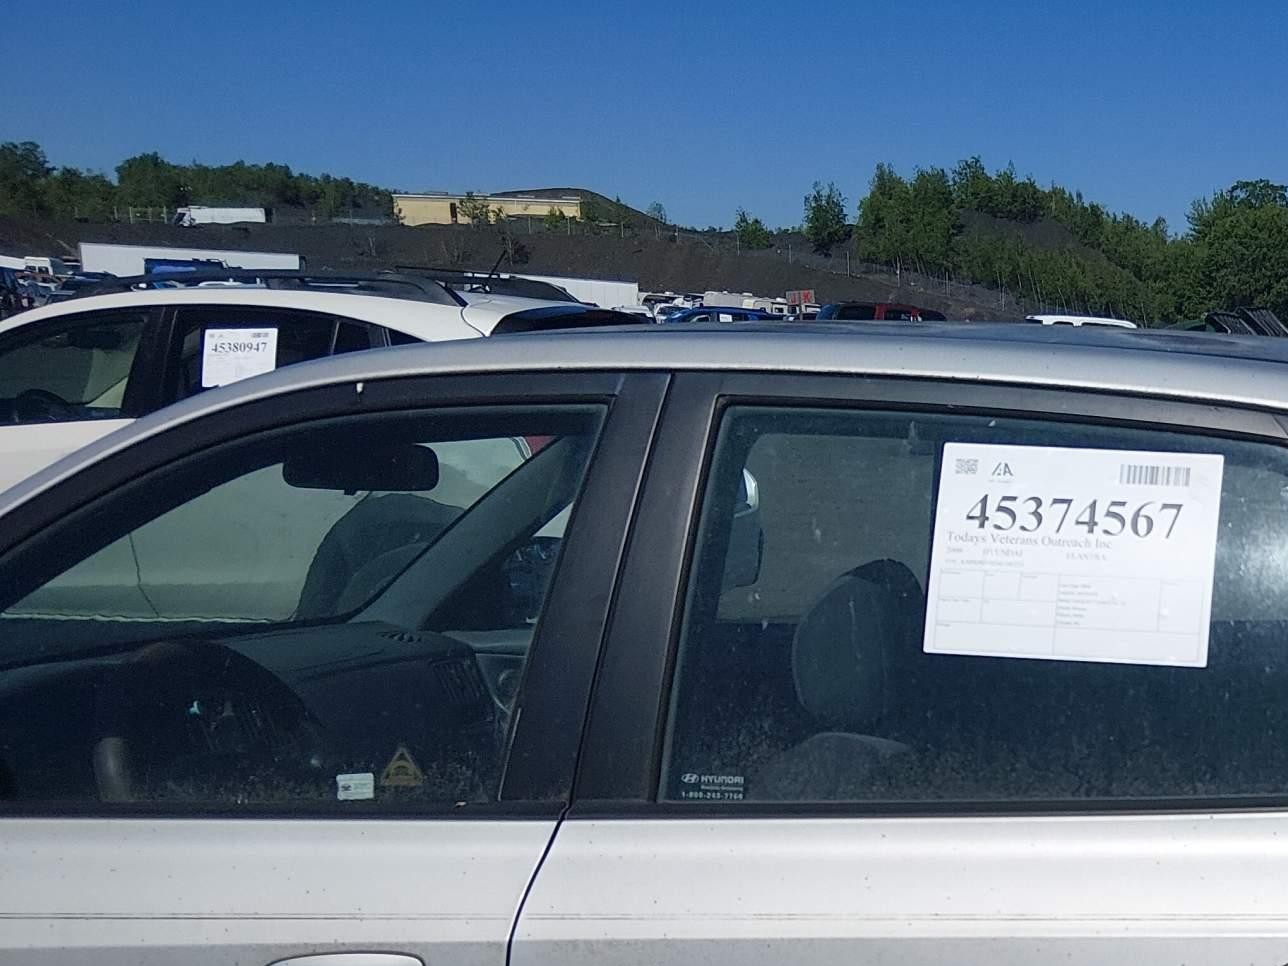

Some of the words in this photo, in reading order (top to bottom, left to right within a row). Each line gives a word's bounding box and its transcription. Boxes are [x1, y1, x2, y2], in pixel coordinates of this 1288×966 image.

[211, 342, 268, 353] 45380947
[966, 494, 1183, 539] 45374567
[947, 531, 987, 546] Todays
[990, 533, 1038, 545] Veterans
[1041, 535, 1090, 549] Outreach
[701, 775, 744, 784] HYUNDAI
